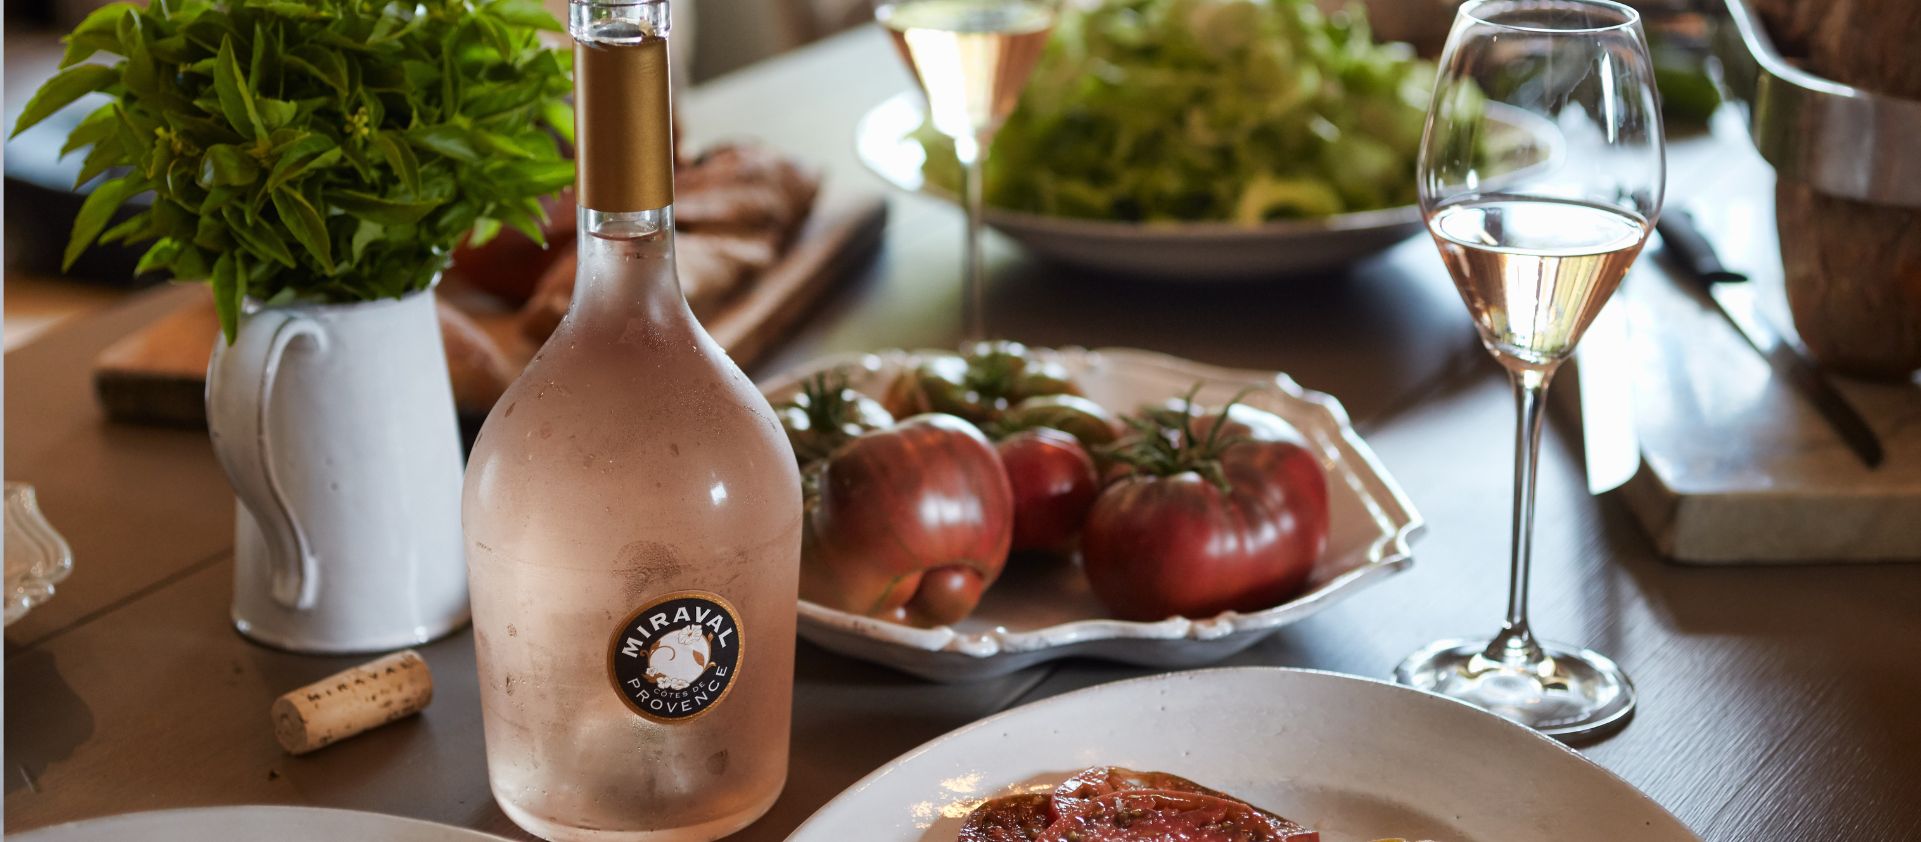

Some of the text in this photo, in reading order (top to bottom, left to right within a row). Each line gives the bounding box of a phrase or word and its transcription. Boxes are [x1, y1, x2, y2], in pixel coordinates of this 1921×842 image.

[621, 606, 733, 658] MIRAVAL
[626, 665, 728, 713] PROVENCE
[692, 681, 705, 693] DE
